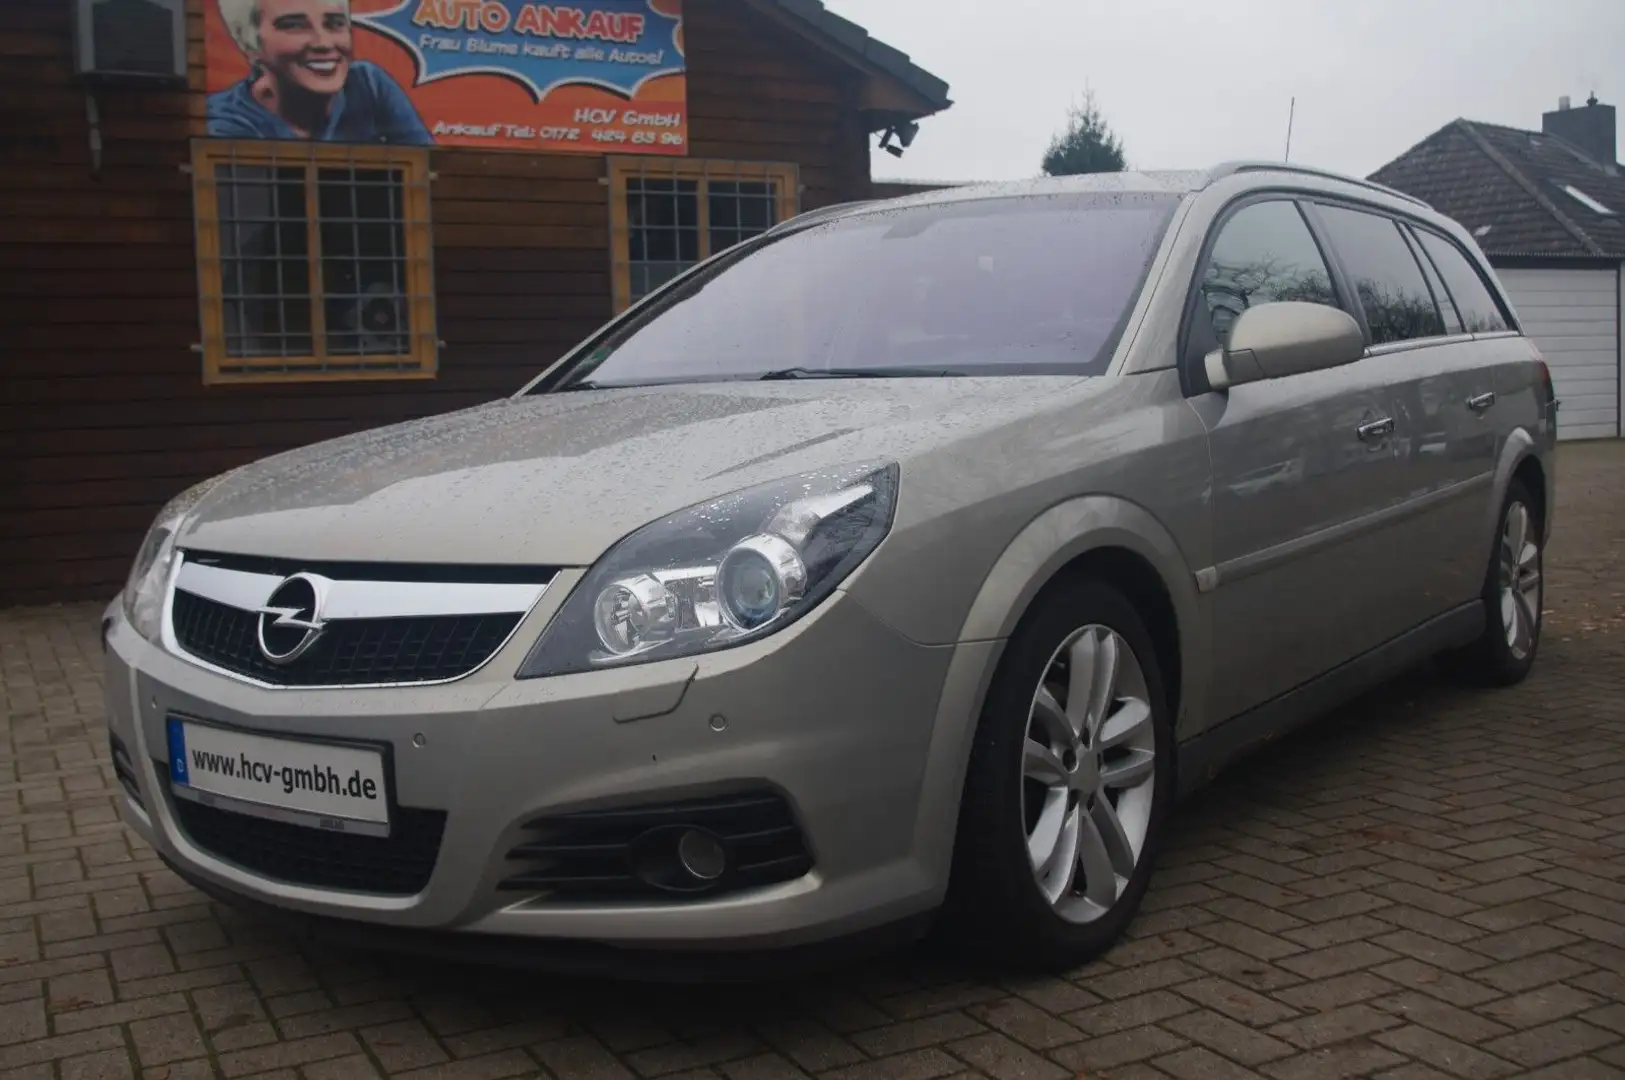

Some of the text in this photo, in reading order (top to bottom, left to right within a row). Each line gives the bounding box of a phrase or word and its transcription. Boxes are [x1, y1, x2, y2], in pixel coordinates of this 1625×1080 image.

[412, 0, 645, 44] AUTO ANKAUF
[420, 33, 461, 51] Frau
[466, 37, 518, 55] Blume
[523, 41, 571, 59] kauft
[574, 46, 605, 61] alle
[432, 120, 502, 137] Ankauf
[540, 126, 581, 141] 0172
[573, 107, 681, 127] HCV GmbH
[192, 749, 377, 800] www.hcv-gmbh.de
